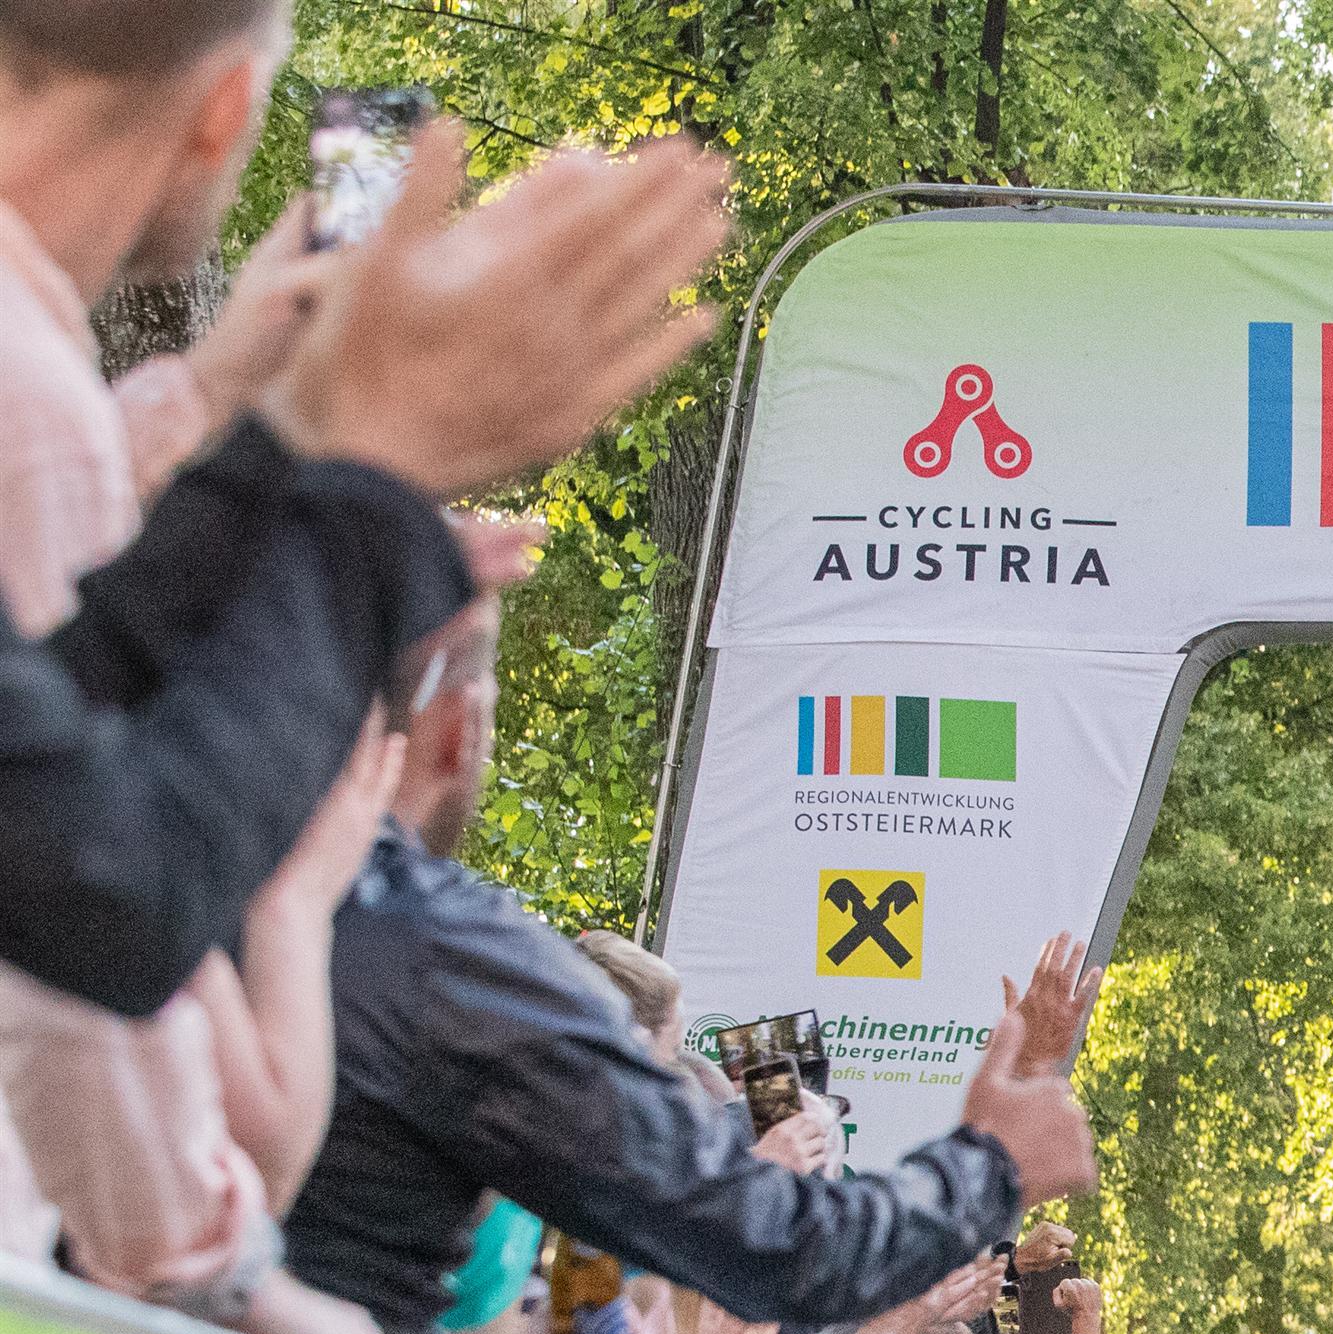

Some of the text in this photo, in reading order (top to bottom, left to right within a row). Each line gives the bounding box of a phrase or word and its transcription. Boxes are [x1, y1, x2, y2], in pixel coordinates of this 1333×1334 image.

[879, 506, 1052, 531] CYCLING
[812, 543, 1111, 586] AUSTRIA
[794, 790, 1016, 812] REGIONALENTWICKLUNG
[794, 812, 1014, 839] OSTSTEIERMARK
[820, 1015, 991, 1050] chinenring
[824, 1043, 958, 1063] tbergerland
[832, 1066, 964, 1085] ofis vom Land
